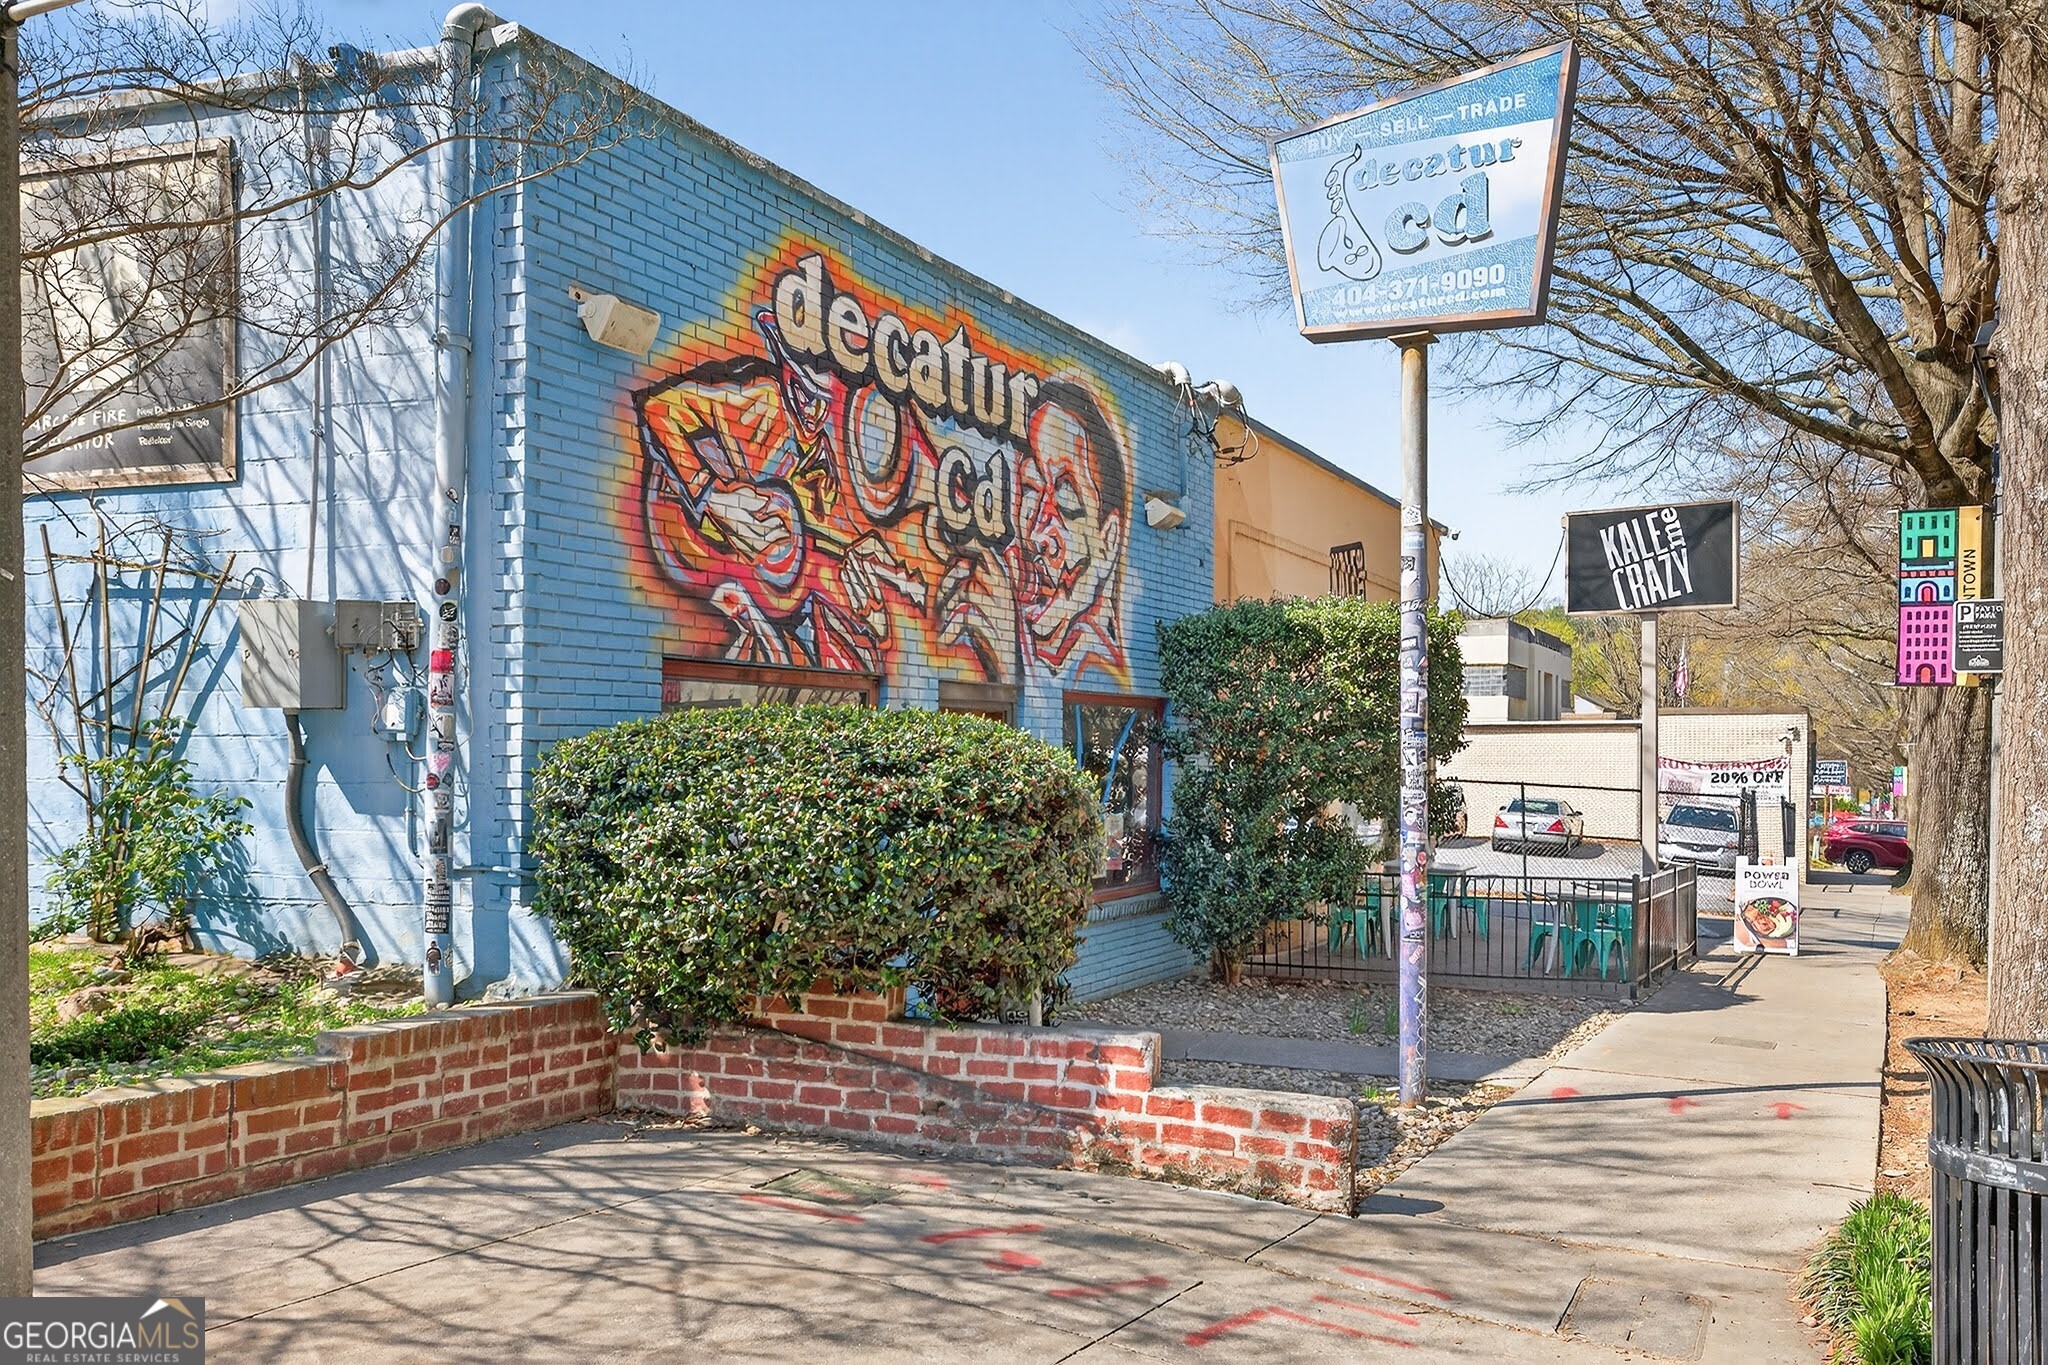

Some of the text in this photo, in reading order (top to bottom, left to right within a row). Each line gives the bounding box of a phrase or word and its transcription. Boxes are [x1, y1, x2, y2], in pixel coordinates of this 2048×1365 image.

[1308, 93, 1528, 150] BUY SELL TRADE
[1352, 137, 1523, 192] decatur
[1384, 171, 1495, 255] cd
[1332, 263, 1506, 307] 404-371-9090
[772, 253, 1041, 440] decatur
[92, 408, 127, 426] FIRE
[936, 446, 1008, 541] cd
[1599, 510, 1670, 571] KALE
[1611, 547, 1694, 611] CRAZY
[1960, 605, 1972, 621] P
[1710, 769, 1785, 784] 20% OFF
